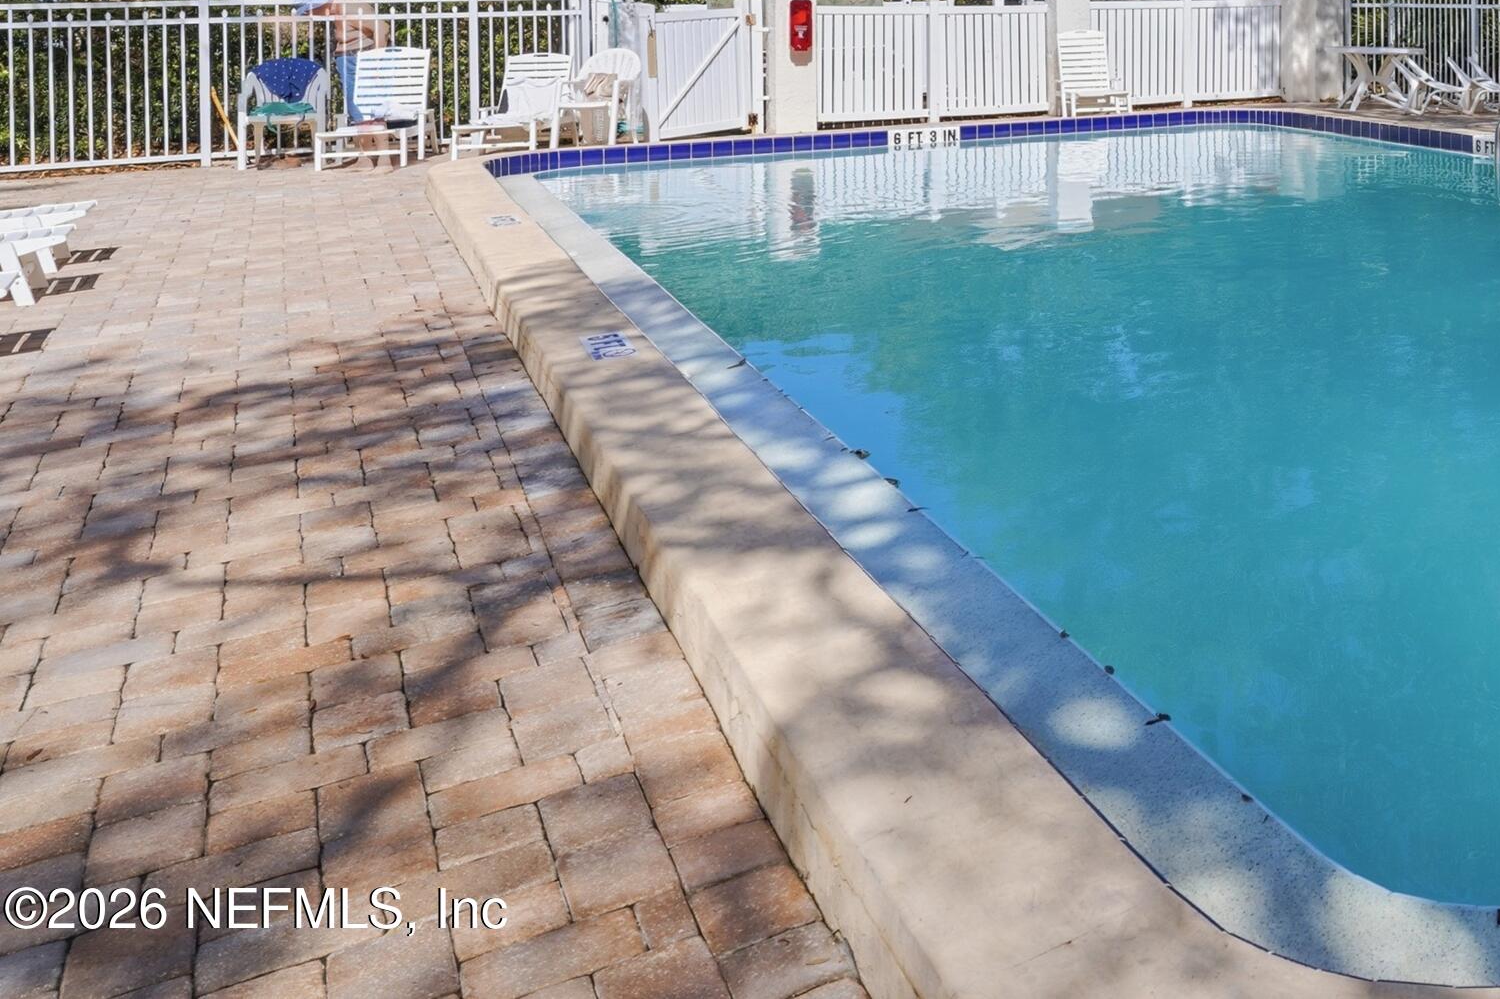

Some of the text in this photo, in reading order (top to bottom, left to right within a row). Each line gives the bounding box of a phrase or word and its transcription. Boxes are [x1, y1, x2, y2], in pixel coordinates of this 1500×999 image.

[894, 133, 901, 145] 6
[929, 130, 937, 143] 3
[943, 129, 959, 142] IN.
